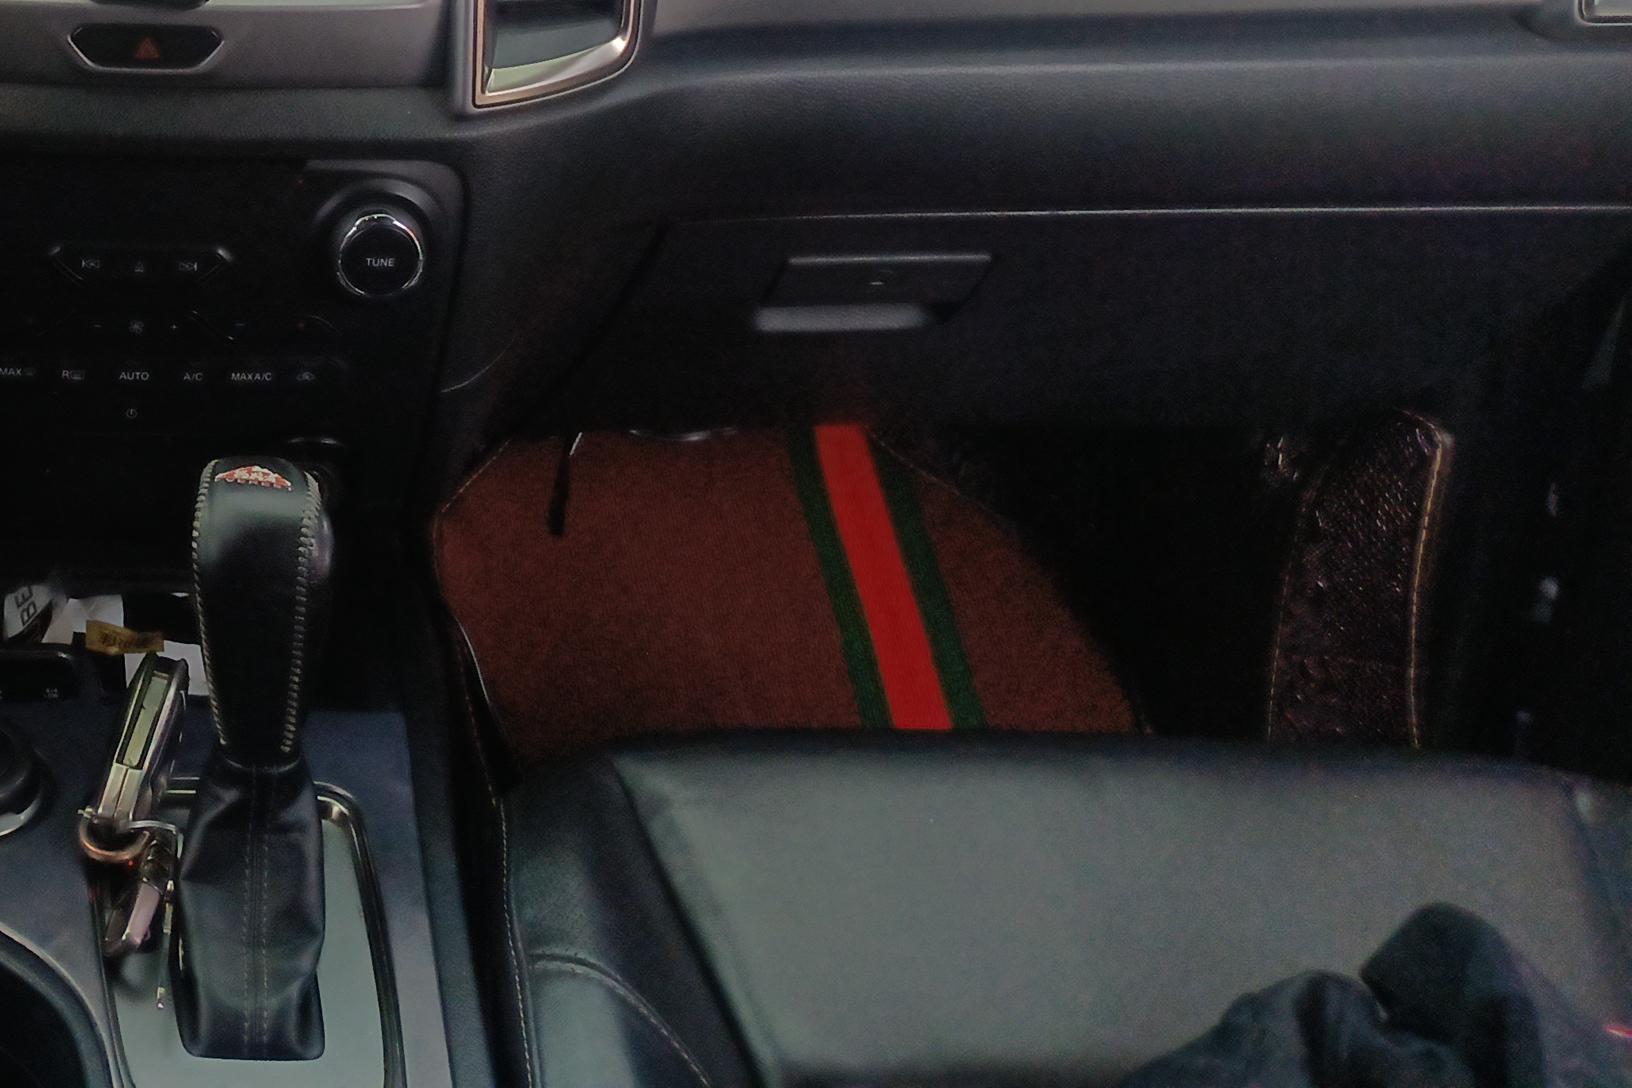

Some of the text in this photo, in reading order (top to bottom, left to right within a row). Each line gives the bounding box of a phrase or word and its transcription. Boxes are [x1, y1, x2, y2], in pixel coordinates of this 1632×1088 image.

[365, 257, 395, 268] TUNE
[118, 371, 150, 381] AUTO
[183, 371, 204, 382] A/C
